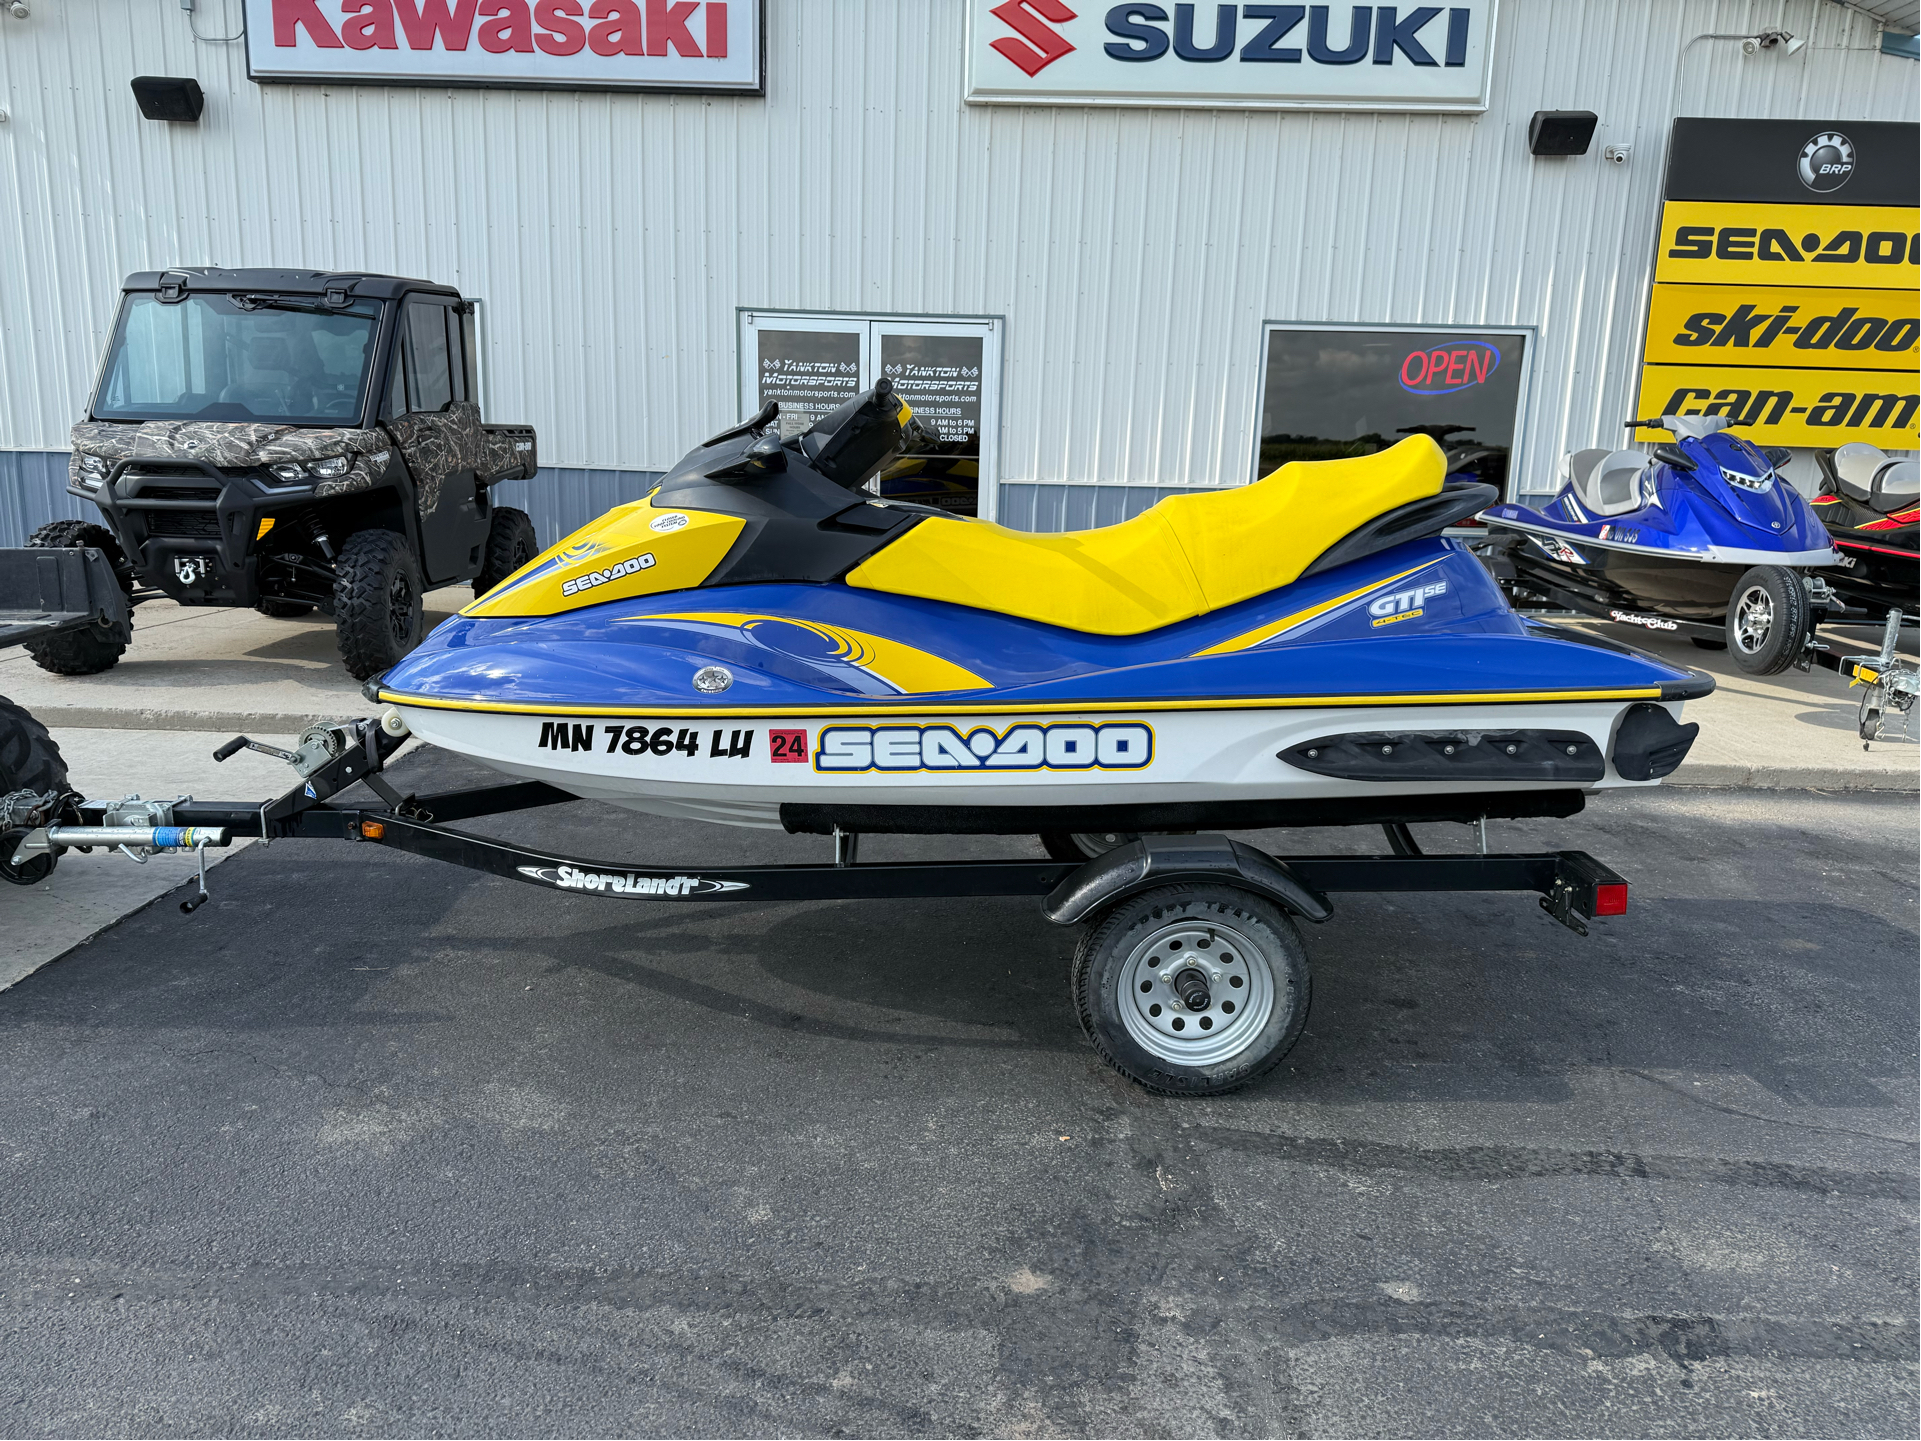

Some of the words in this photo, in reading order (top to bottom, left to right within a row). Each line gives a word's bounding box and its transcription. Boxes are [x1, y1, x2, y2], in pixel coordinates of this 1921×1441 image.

[271, 0, 728, 58] Kawasaki
[1103, 3, 1471, 67] SUZUKI
[1819, 164, 1852, 175] BRP
[783, 359, 838, 373] YANKTON
[905, 364, 960, 377] YANKTON
[1401, 350, 1491, 386] OPEN
[762, 372, 857, 387] MOTORSPORTS
[763, 388, 856, 399] yanktonmotorsports.com
[778, 401, 814, 410] BUSINESS
[815, 403, 841, 411] HOURS
[936, 407, 962, 415] HOURS
[939, 434, 969, 442] CLOSED
[1369, 588, 1424, 616] GTI
[1424, 580, 1447, 599] SE
[538, 722, 594, 752] MN
[604, 726, 699, 757] 7864
[710, 729, 754, 758] LU
[771, 735, 804, 757] 24
